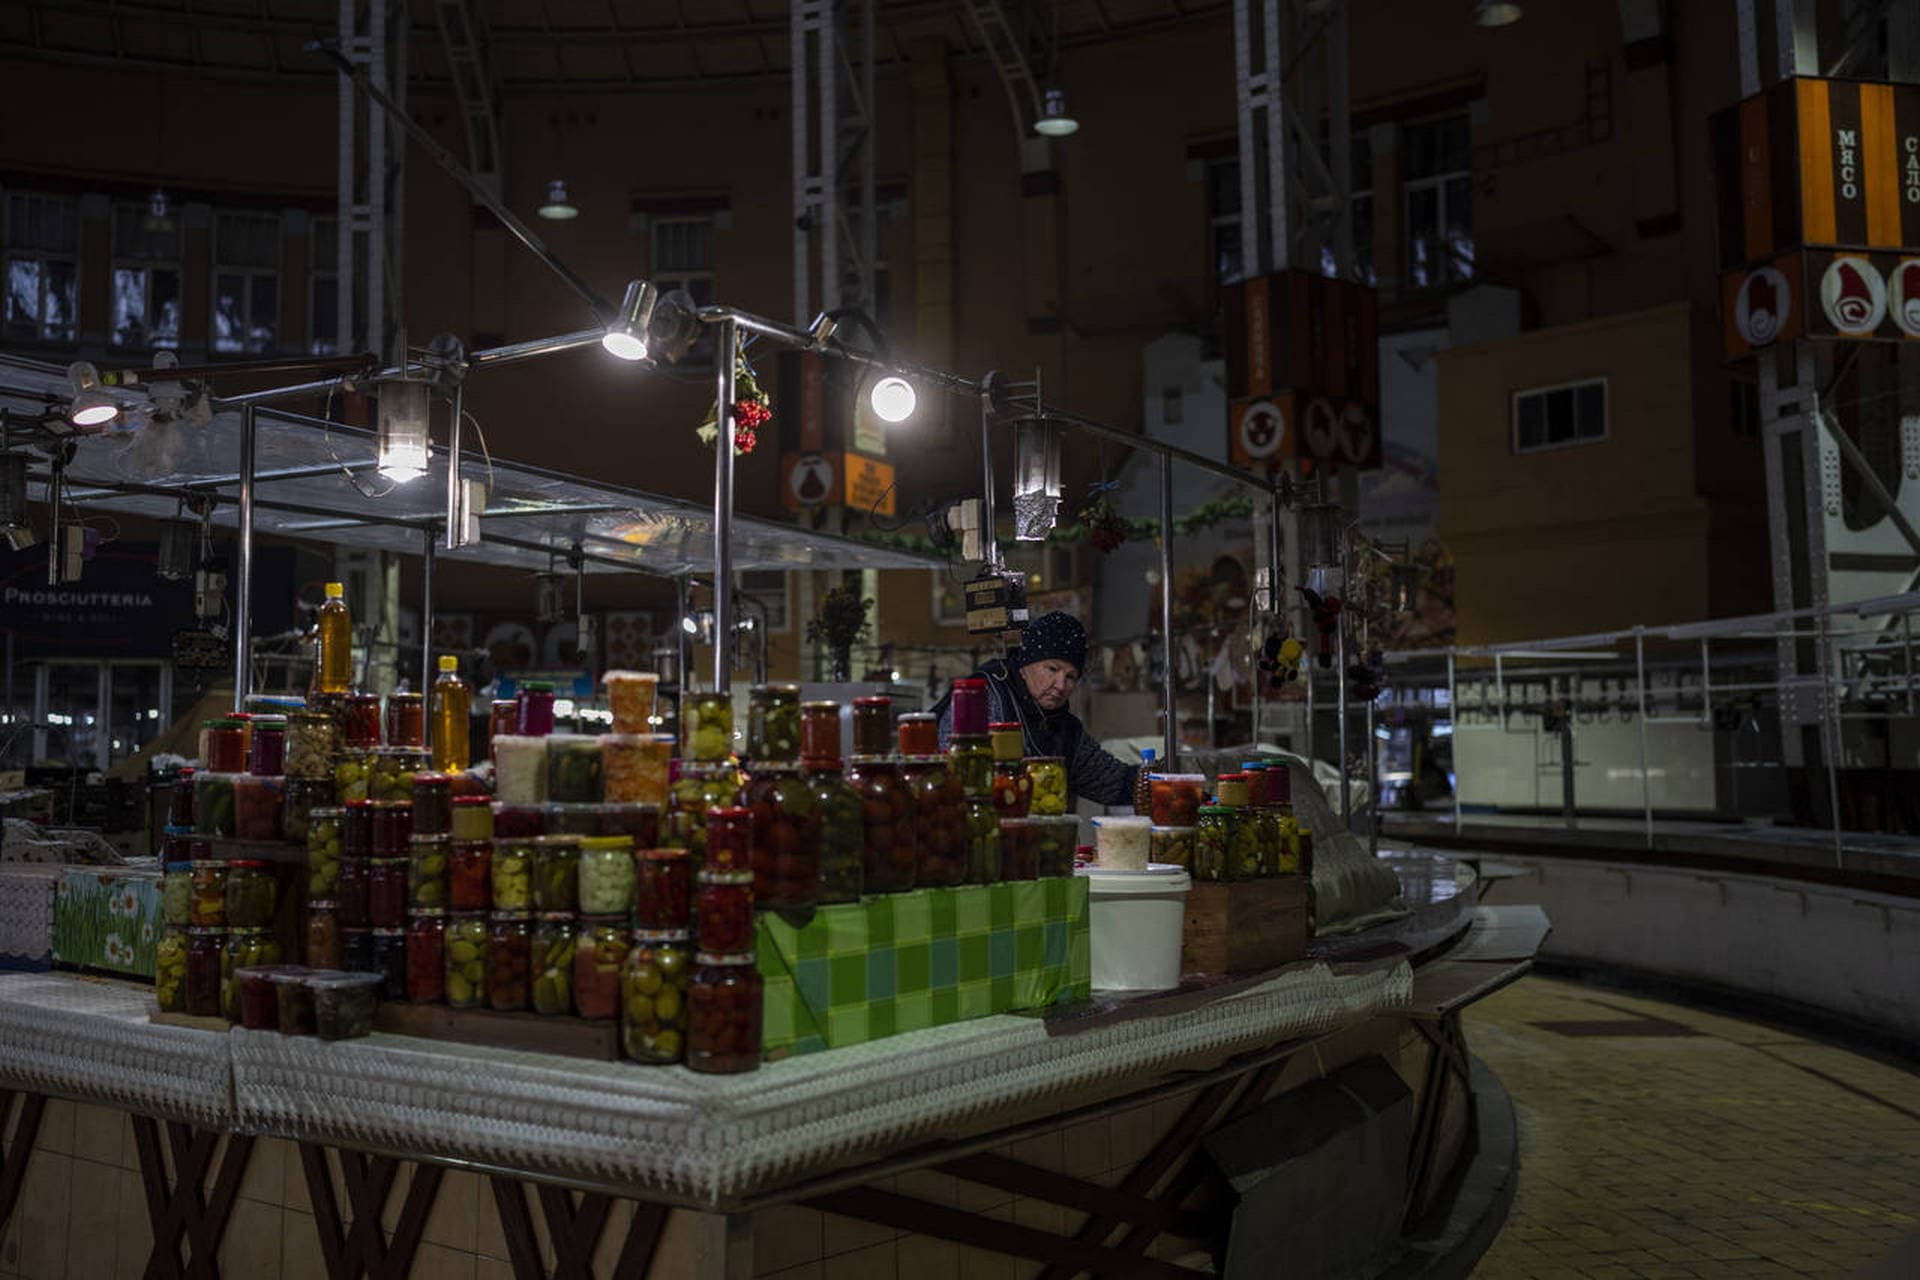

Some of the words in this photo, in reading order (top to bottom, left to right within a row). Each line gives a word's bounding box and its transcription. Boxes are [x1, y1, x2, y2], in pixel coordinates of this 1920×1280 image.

[1837, 129, 1857, 199] МЯСО
[1904, 136, 1920, 203] САЛО
[4, 586, 153, 607] PROSCIUTTERIA
